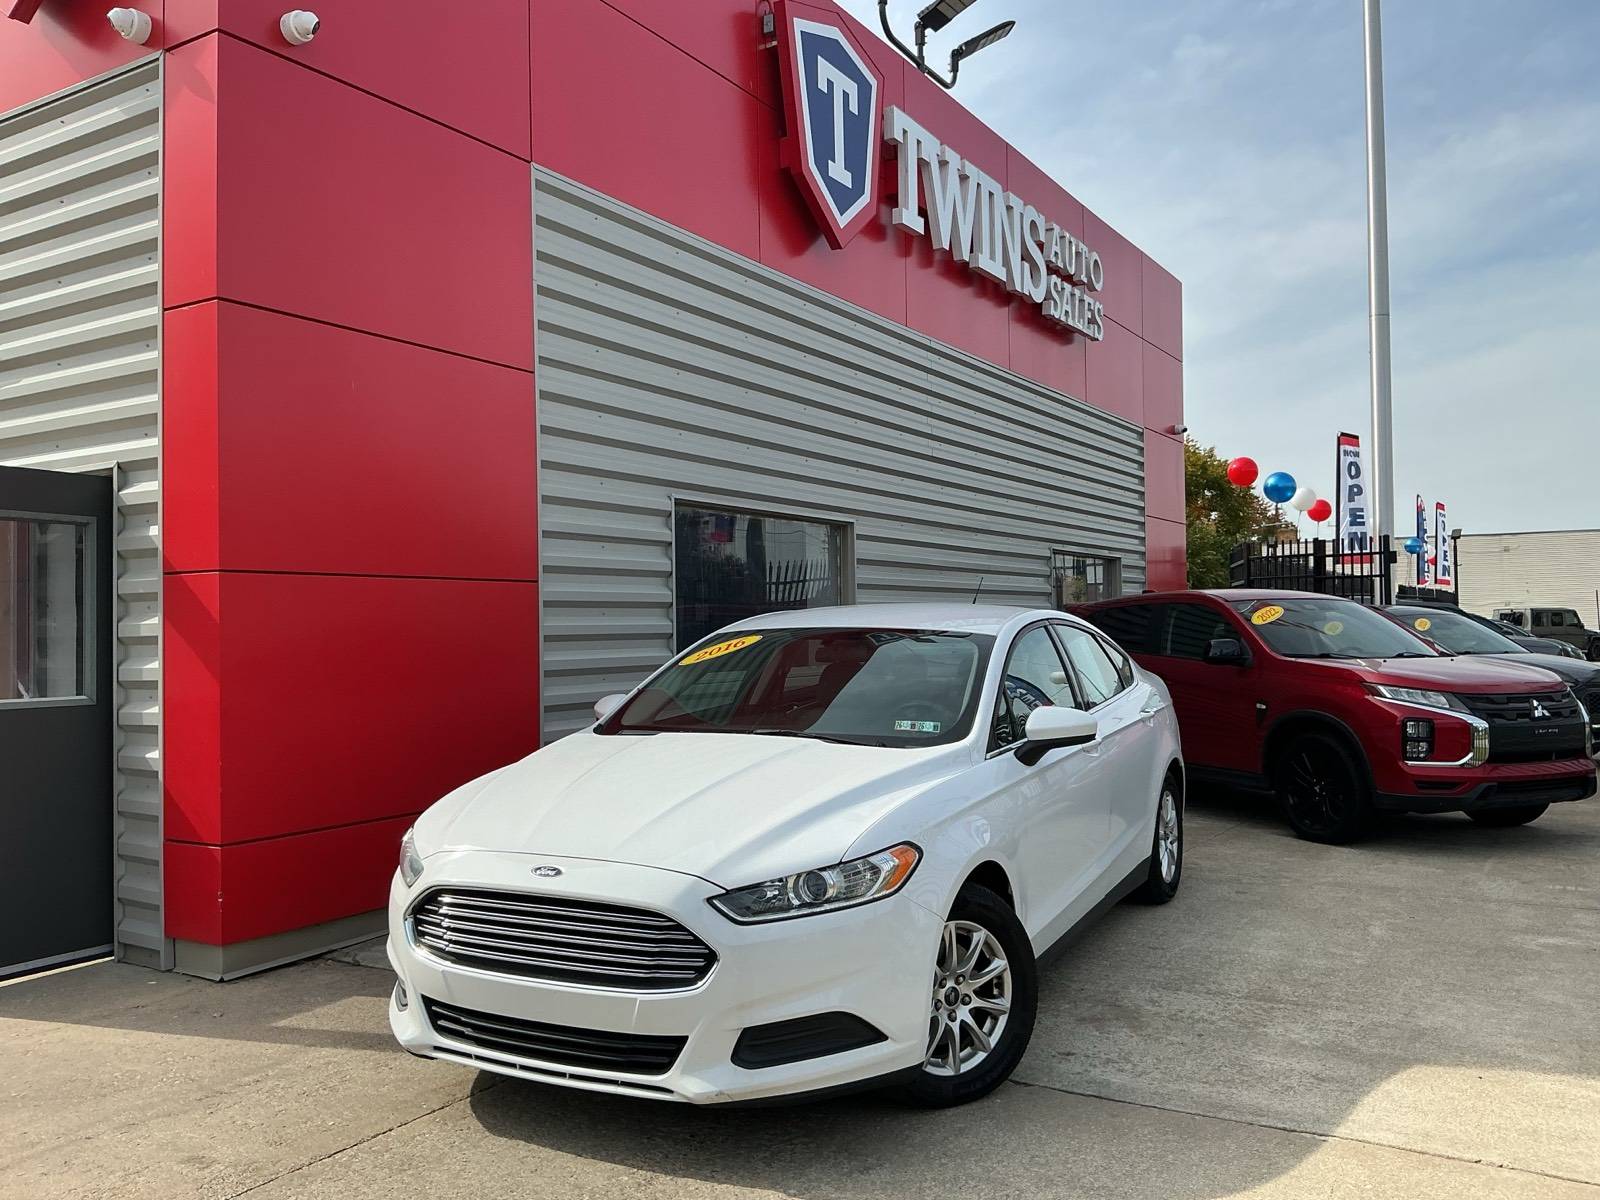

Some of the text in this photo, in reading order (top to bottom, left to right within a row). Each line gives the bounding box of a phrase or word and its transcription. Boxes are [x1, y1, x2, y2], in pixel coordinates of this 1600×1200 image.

[817, 54, 859, 189] T
[884, 104, 1047, 303] TWINS
[1045, 221, 1104, 292] AUTO
[1042, 275, 1104, 341] SALES
[1347, 461, 1368, 551] OPEN
[1441, 519, 1451, 577] OPEN
[695, 640, 746, 660] 2016
